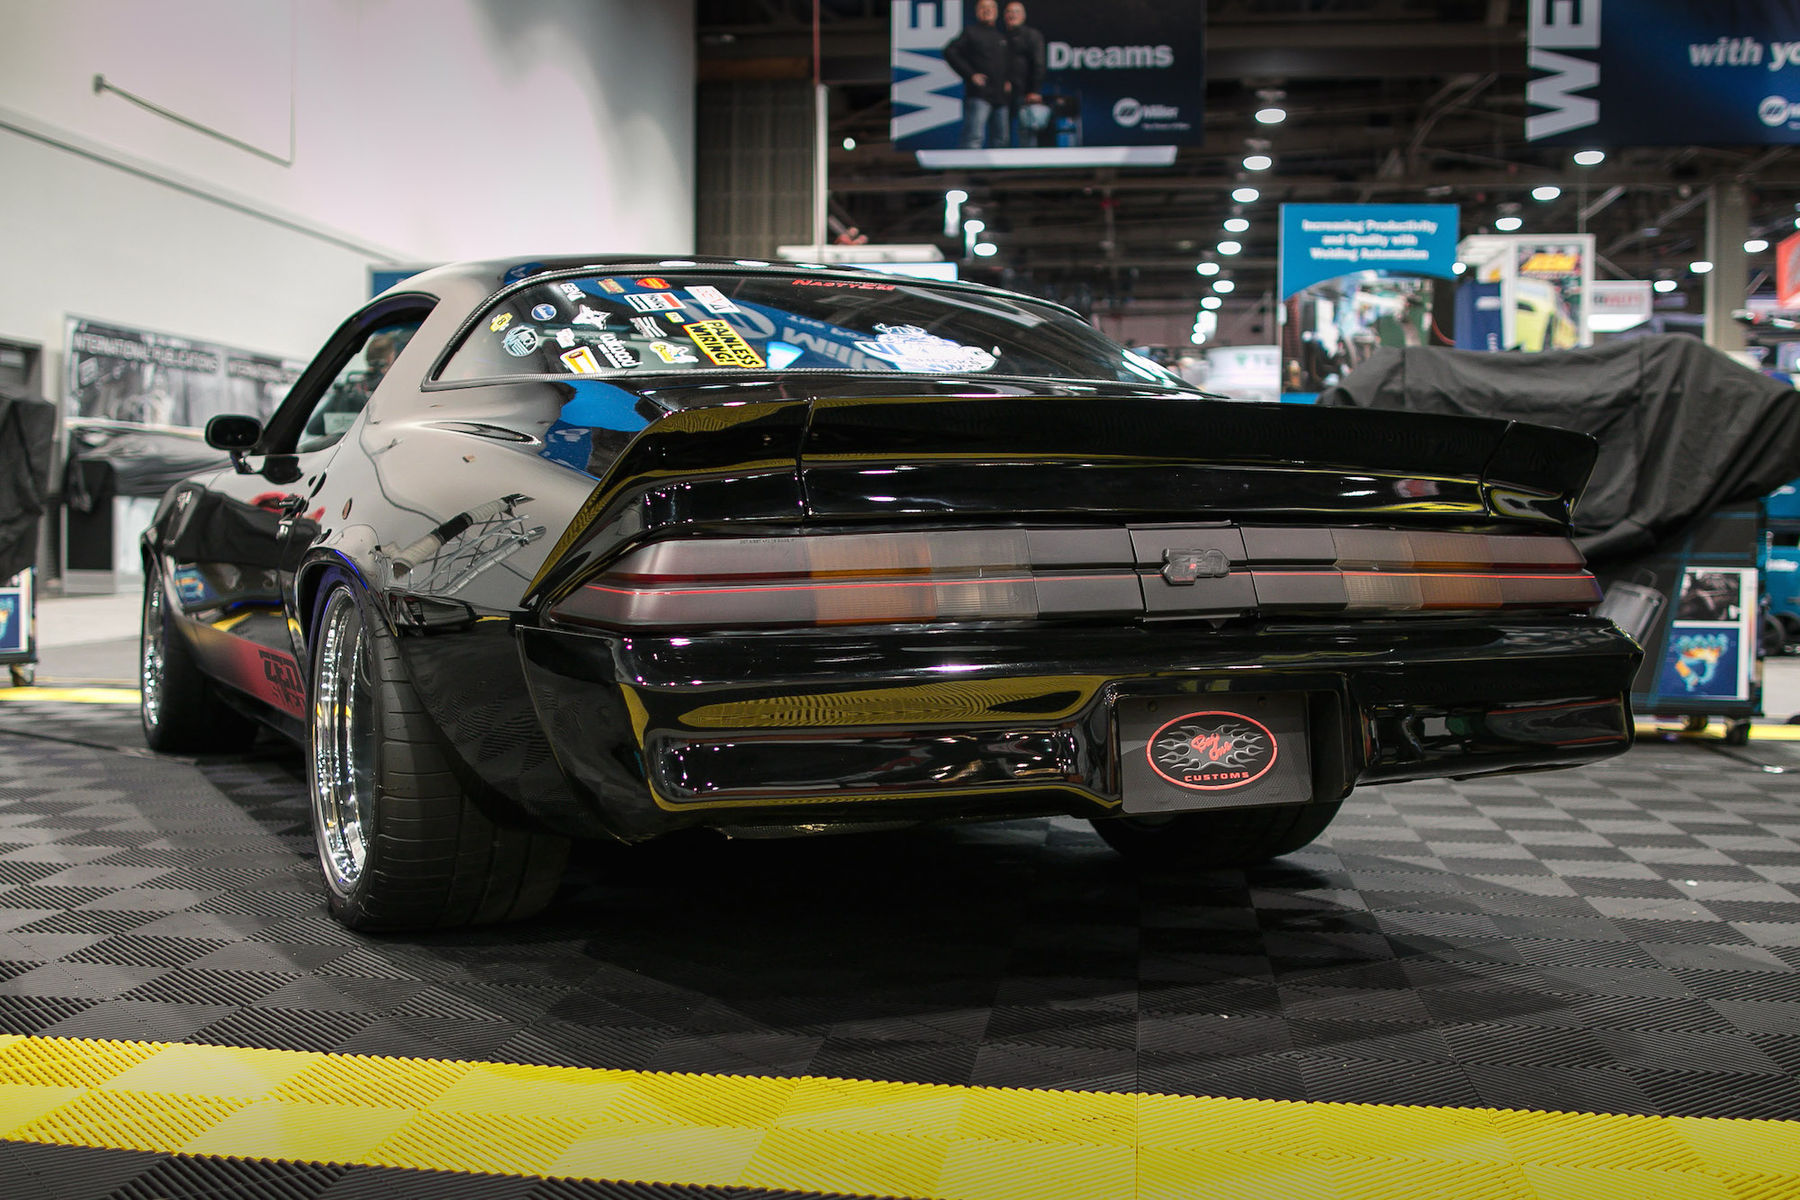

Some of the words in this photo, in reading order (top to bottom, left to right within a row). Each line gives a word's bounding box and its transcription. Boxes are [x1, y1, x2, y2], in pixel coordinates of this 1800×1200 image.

[1047, 42, 1174, 69] Dreams
[1689, 37, 1763, 66] with
[689, 325, 737, 363] WIRING!
[706, 321, 760, 366] PAINLESS
[1184, 771, 1250, 783] CUSTOMS
